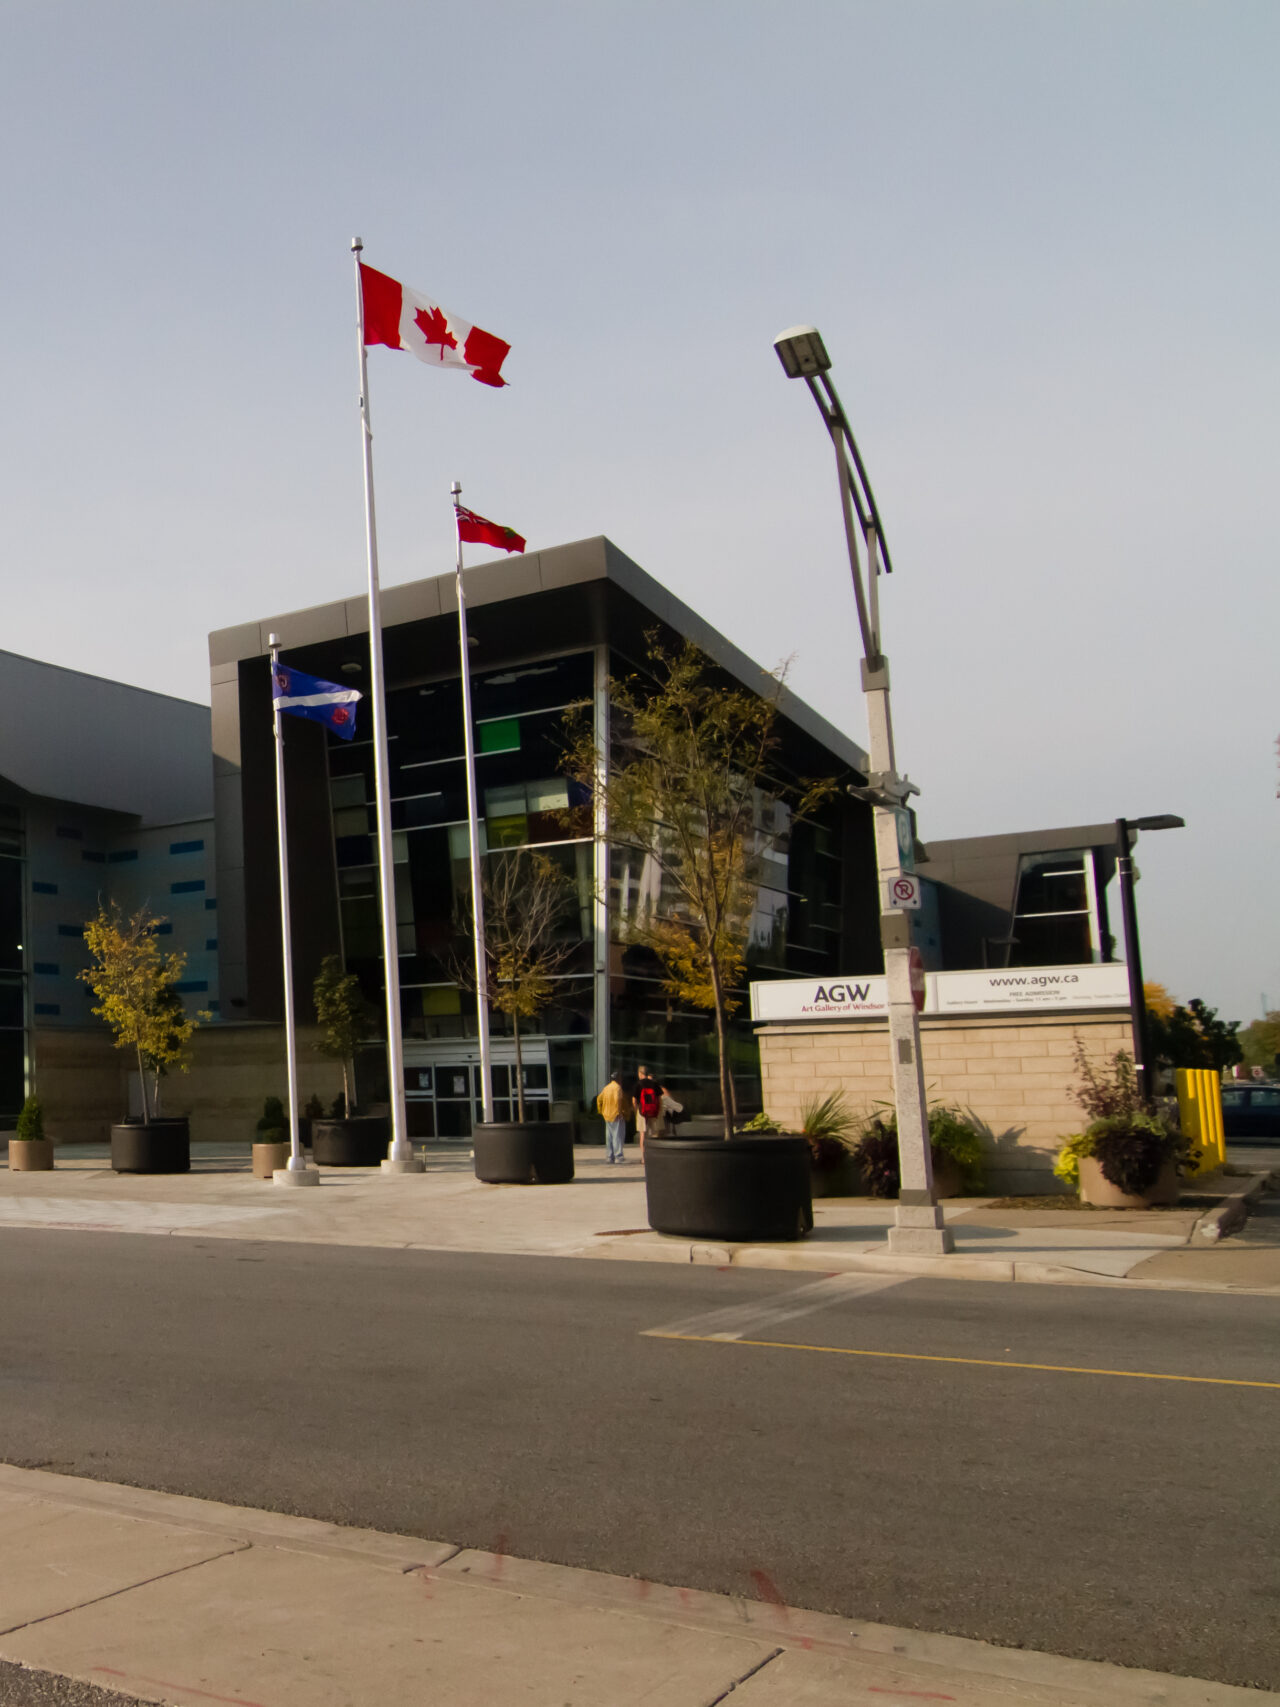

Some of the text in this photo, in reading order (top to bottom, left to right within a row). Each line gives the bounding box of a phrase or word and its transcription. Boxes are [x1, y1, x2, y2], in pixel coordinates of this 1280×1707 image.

[989, 974, 1079, 987] www.agw.ca
[814, 984, 870, 1003] AGW
[815, 1004, 841, 1012] Gallery
[842, 1003, 851, 1011] of
[853, 1002, 884, 1010] Windsor
